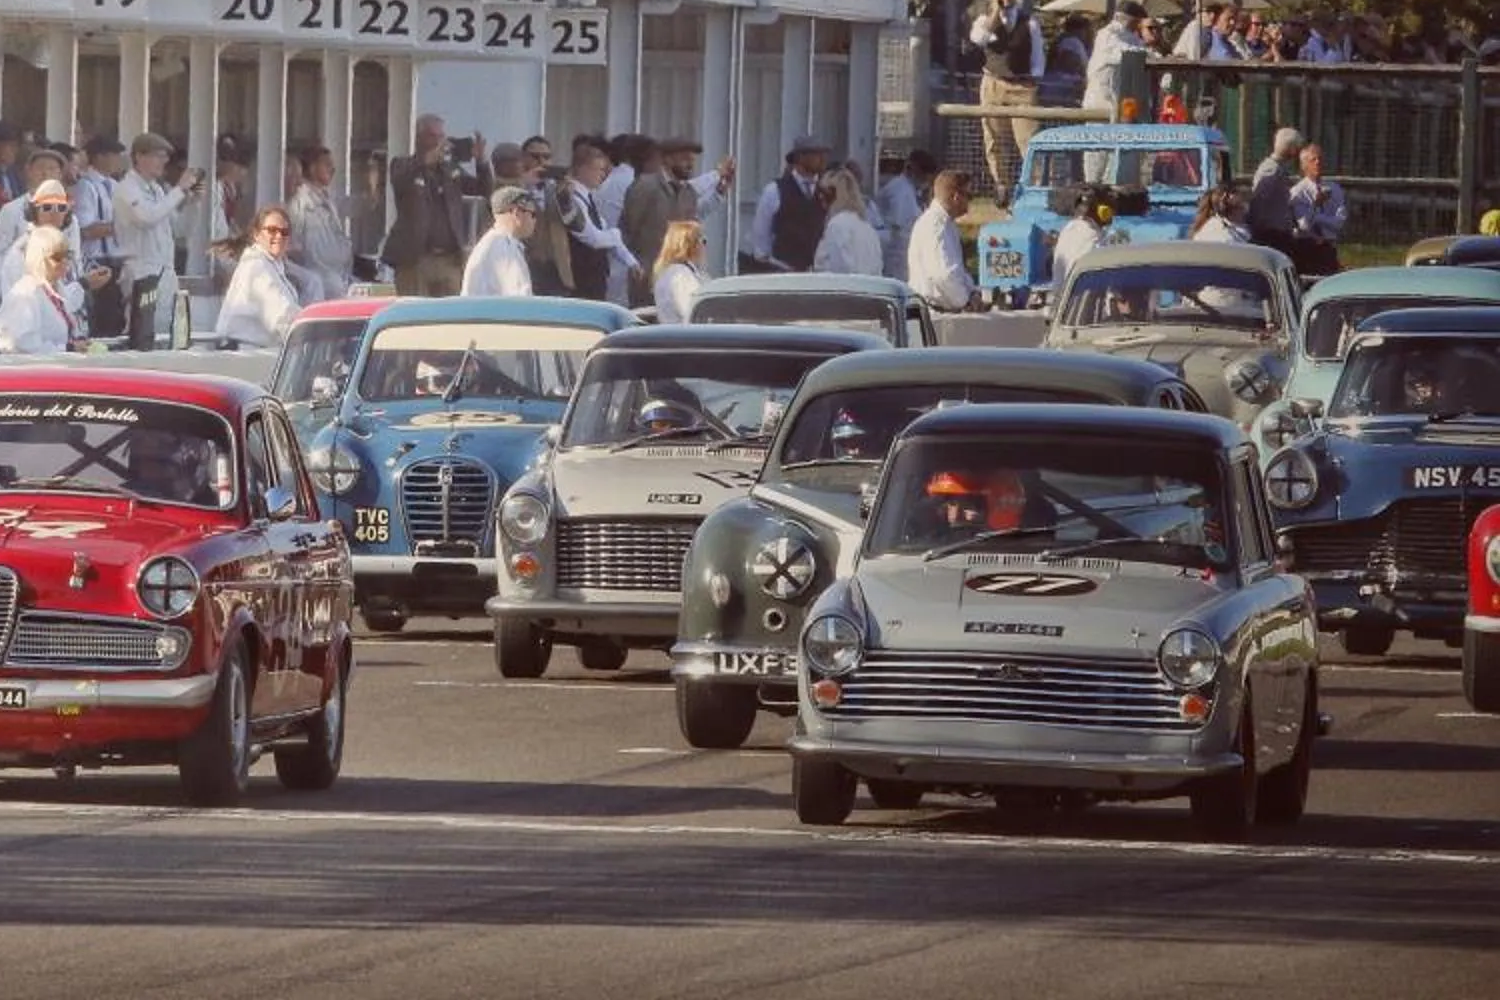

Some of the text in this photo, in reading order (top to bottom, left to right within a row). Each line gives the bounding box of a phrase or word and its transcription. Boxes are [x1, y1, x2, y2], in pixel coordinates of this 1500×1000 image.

[359, 0, 409, 36] 22
[427, 6, 475, 43] 23
[485, 13, 535, 48] 24
[552, 19, 599, 54] 25
[43, 403, 69, 418] del
[1414, 467, 1500, 489] NSV 45
[355, 509, 389, 525] TVC
[355, 526, 389, 542] 405
[976, 575, 1089, 593] 77
